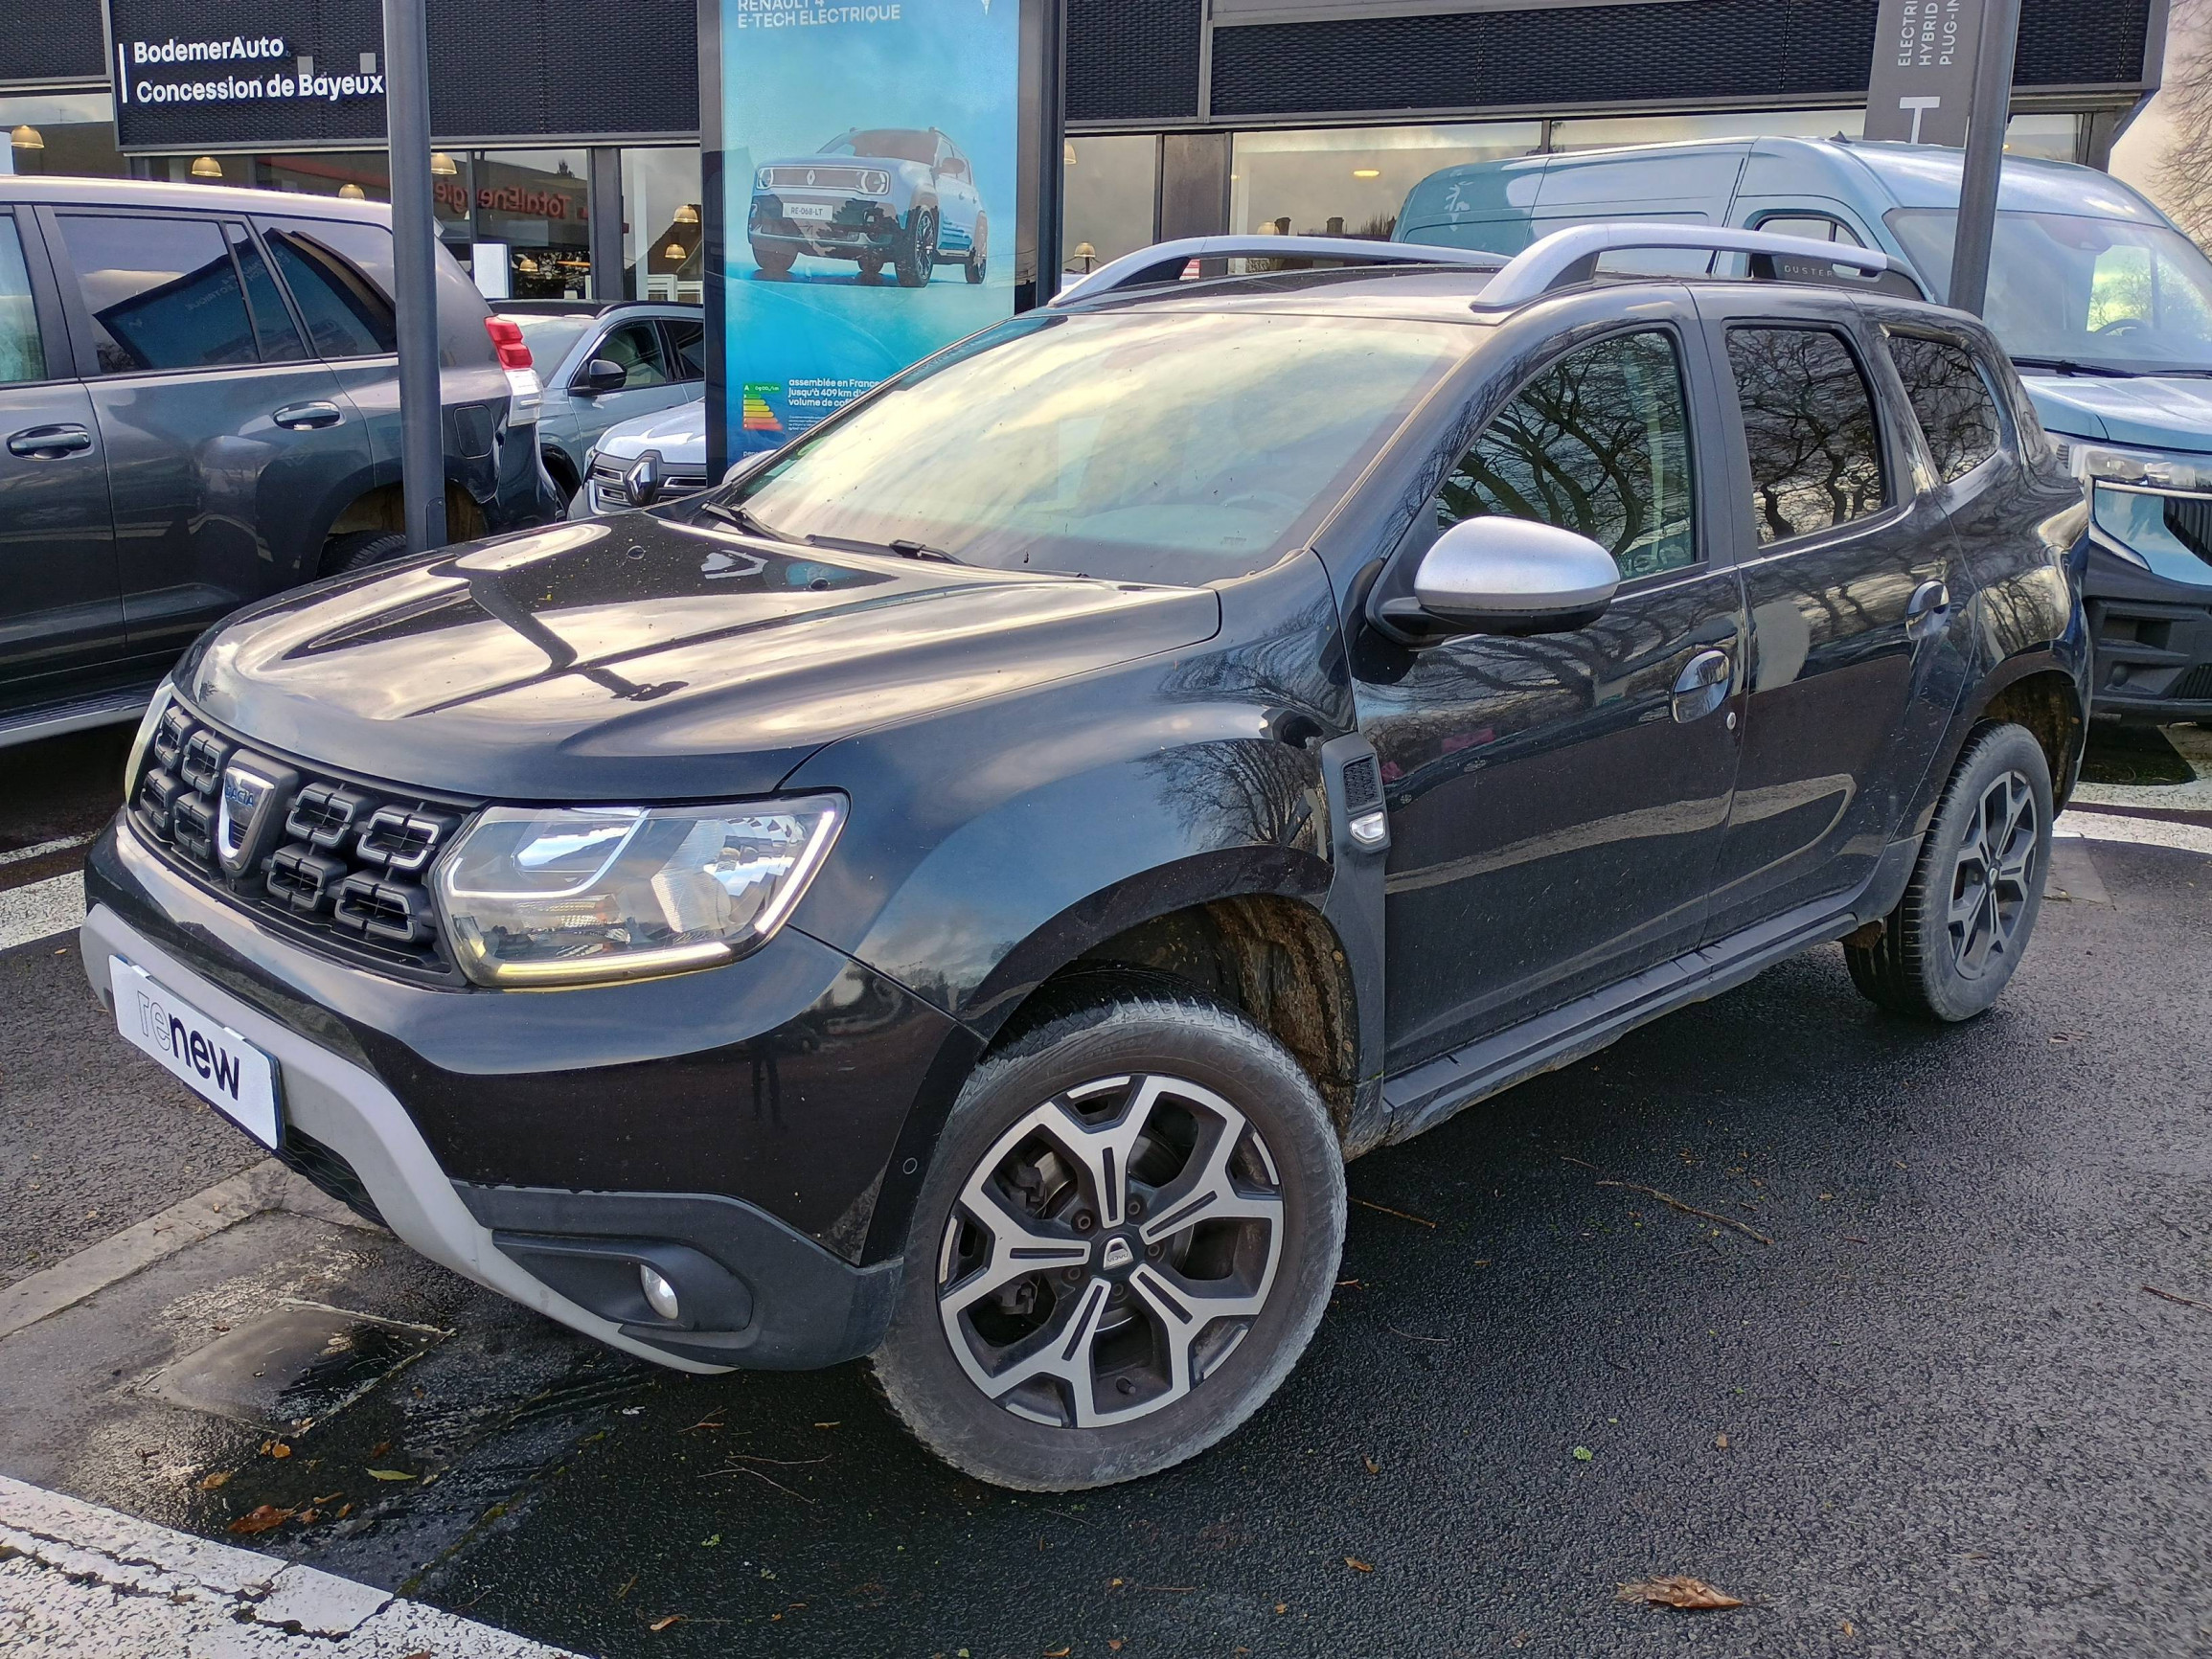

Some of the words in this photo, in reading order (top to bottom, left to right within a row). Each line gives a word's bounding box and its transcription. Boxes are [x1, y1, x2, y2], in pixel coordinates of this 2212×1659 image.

[738, 0, 810, 11] RENAULT
[738, 11, 796, 29] E-TECH
[799, 4, 901, 26] ELECTRIQUE
[1918, 3, 1938, 66] HYBRID
[134, 36, 285, 63] BodemerAuto
[137, 76, 262, 103] Concession
[266, 74, 295, 98] de
[299, 74, 384, 101] Bayeux
[1785, 265, 1833, 278] DUSTER
[788, 377, 836, 387] assemblée
[788, 398, 821, 406] volume
[821, 398, 833, 406] de
[820, 388, 838, 397] 409
[837, 388, 852, 398] km
[225, 784, 255, 807] DACIA
[137, 990, 240, 1101] renew
[1107, 1253, 1129, 1262] DACIA
